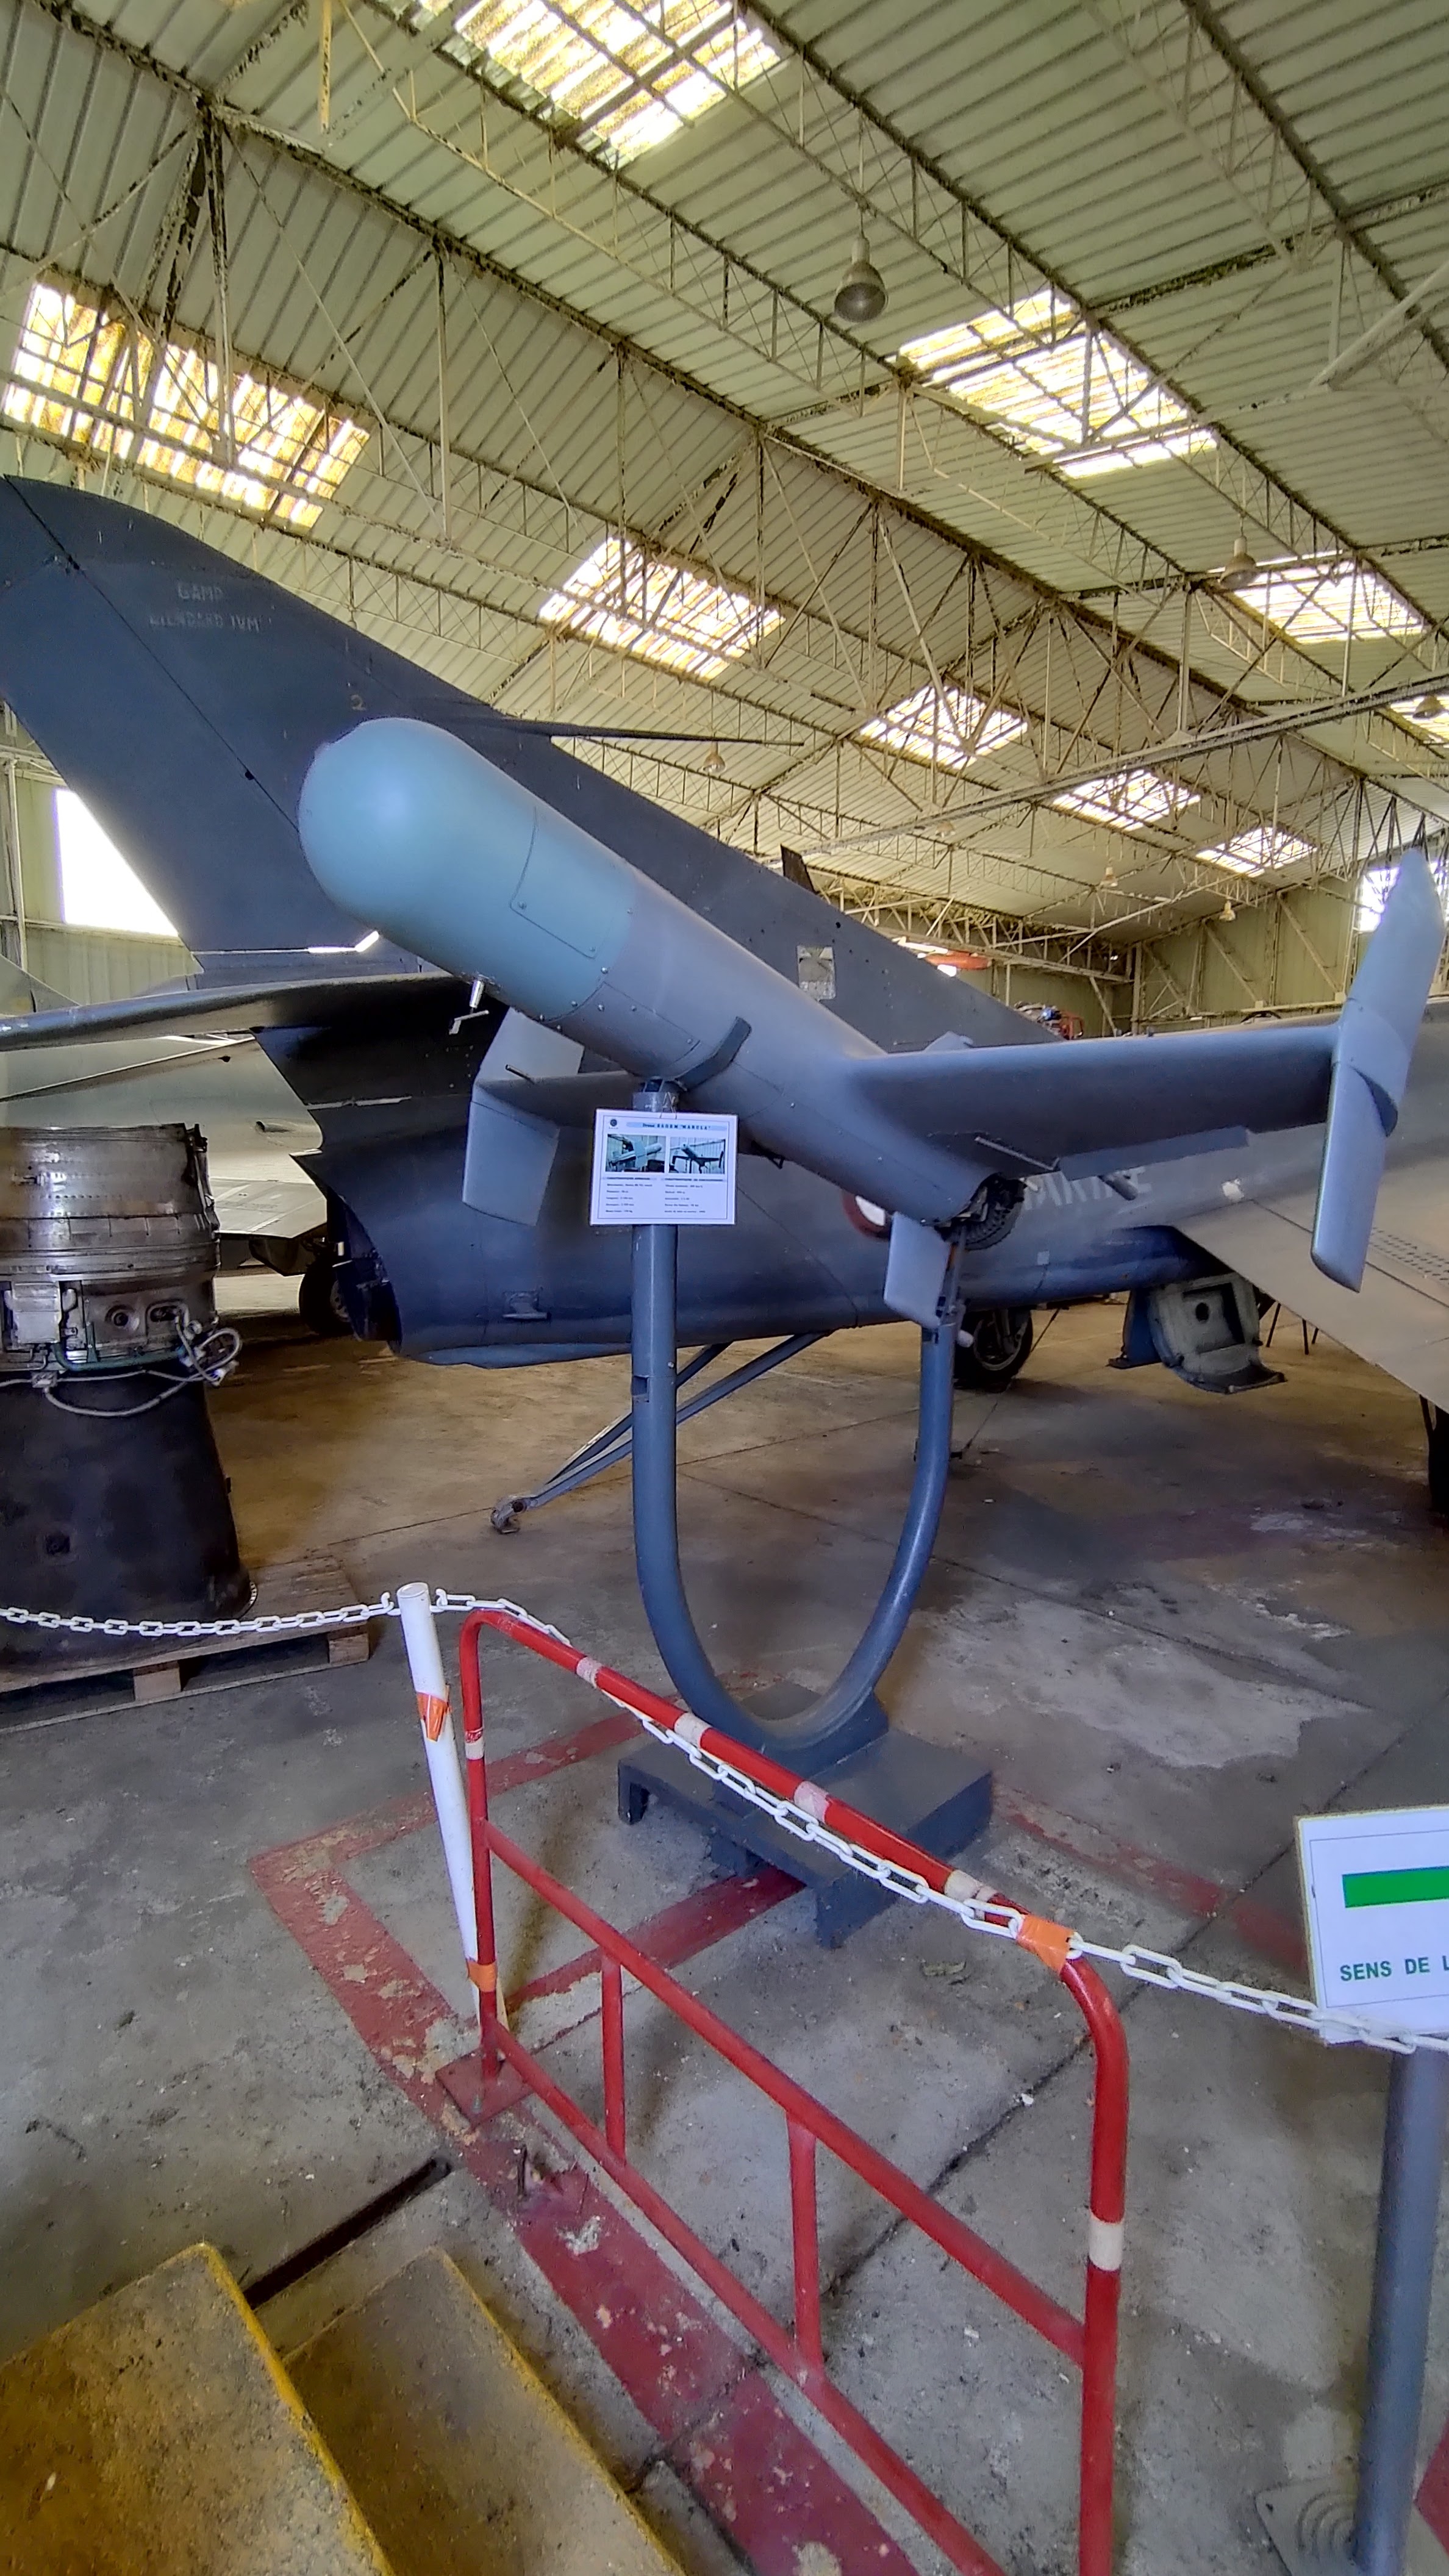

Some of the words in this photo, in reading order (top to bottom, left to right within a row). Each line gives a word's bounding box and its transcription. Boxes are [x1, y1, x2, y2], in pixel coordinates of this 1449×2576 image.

[351, 694, 367, 710] 2
[1340, 1960, 1392, 1981] SENS
[1404, 1956, 1430, 1975] DE
